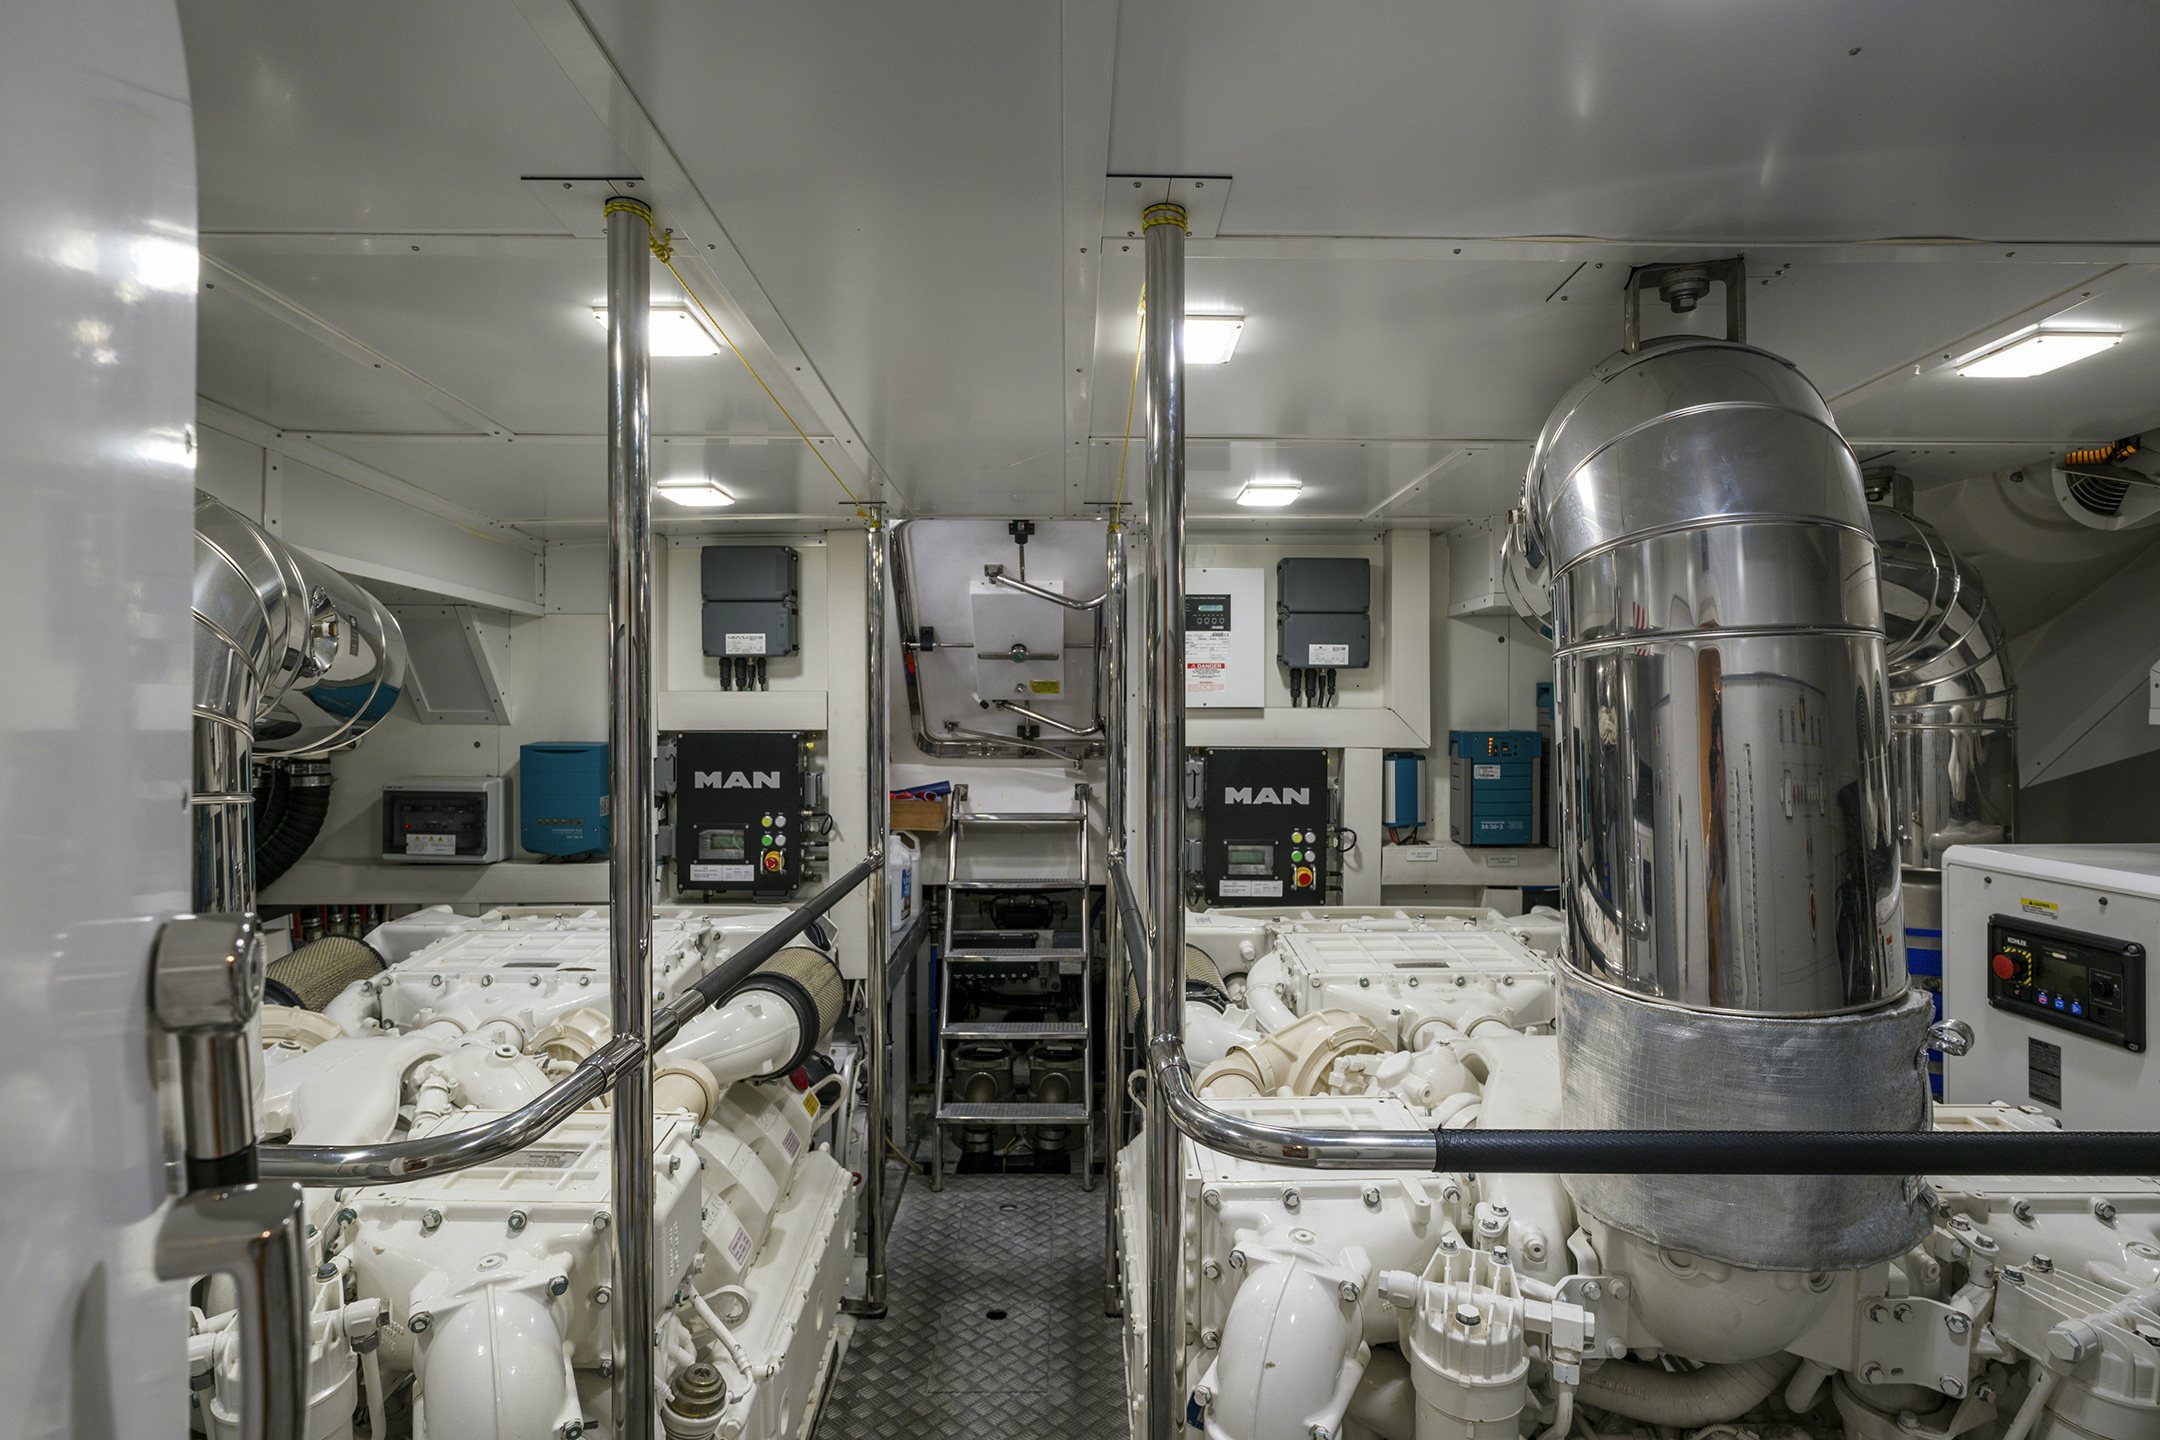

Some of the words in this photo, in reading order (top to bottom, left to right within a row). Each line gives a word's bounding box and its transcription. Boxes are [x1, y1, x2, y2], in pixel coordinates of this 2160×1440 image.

[694, 771, 781, 789] MAN
[1224, 787, 1310, 805] MAN
[2007, 936, 2027, 947] KOHLER
